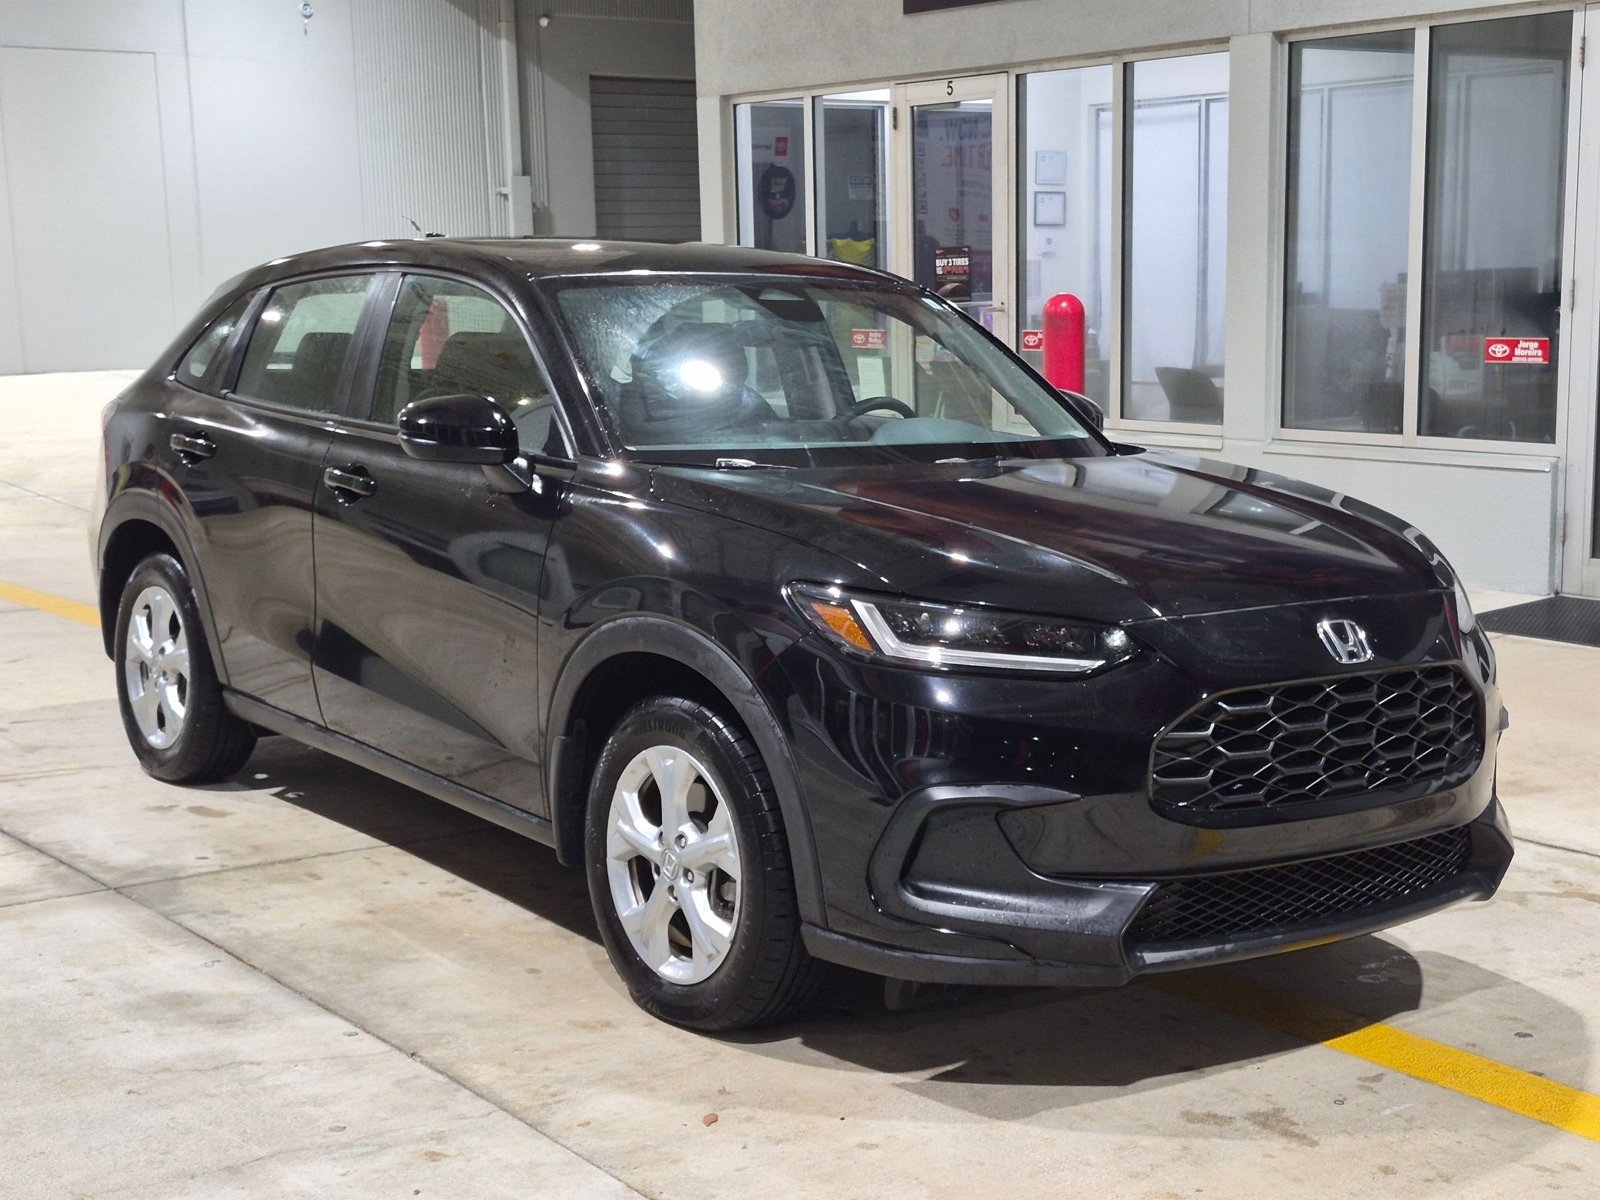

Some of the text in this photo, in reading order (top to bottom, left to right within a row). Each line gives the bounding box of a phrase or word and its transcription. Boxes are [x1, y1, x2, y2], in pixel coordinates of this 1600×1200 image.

[946, 80, 953, 96] 5
[936, 257, 969, 267] BUY 3 TIRES
[1517, 340, 1538, 349] Jorge
[1514, 347, 1542, 356] Moreira
